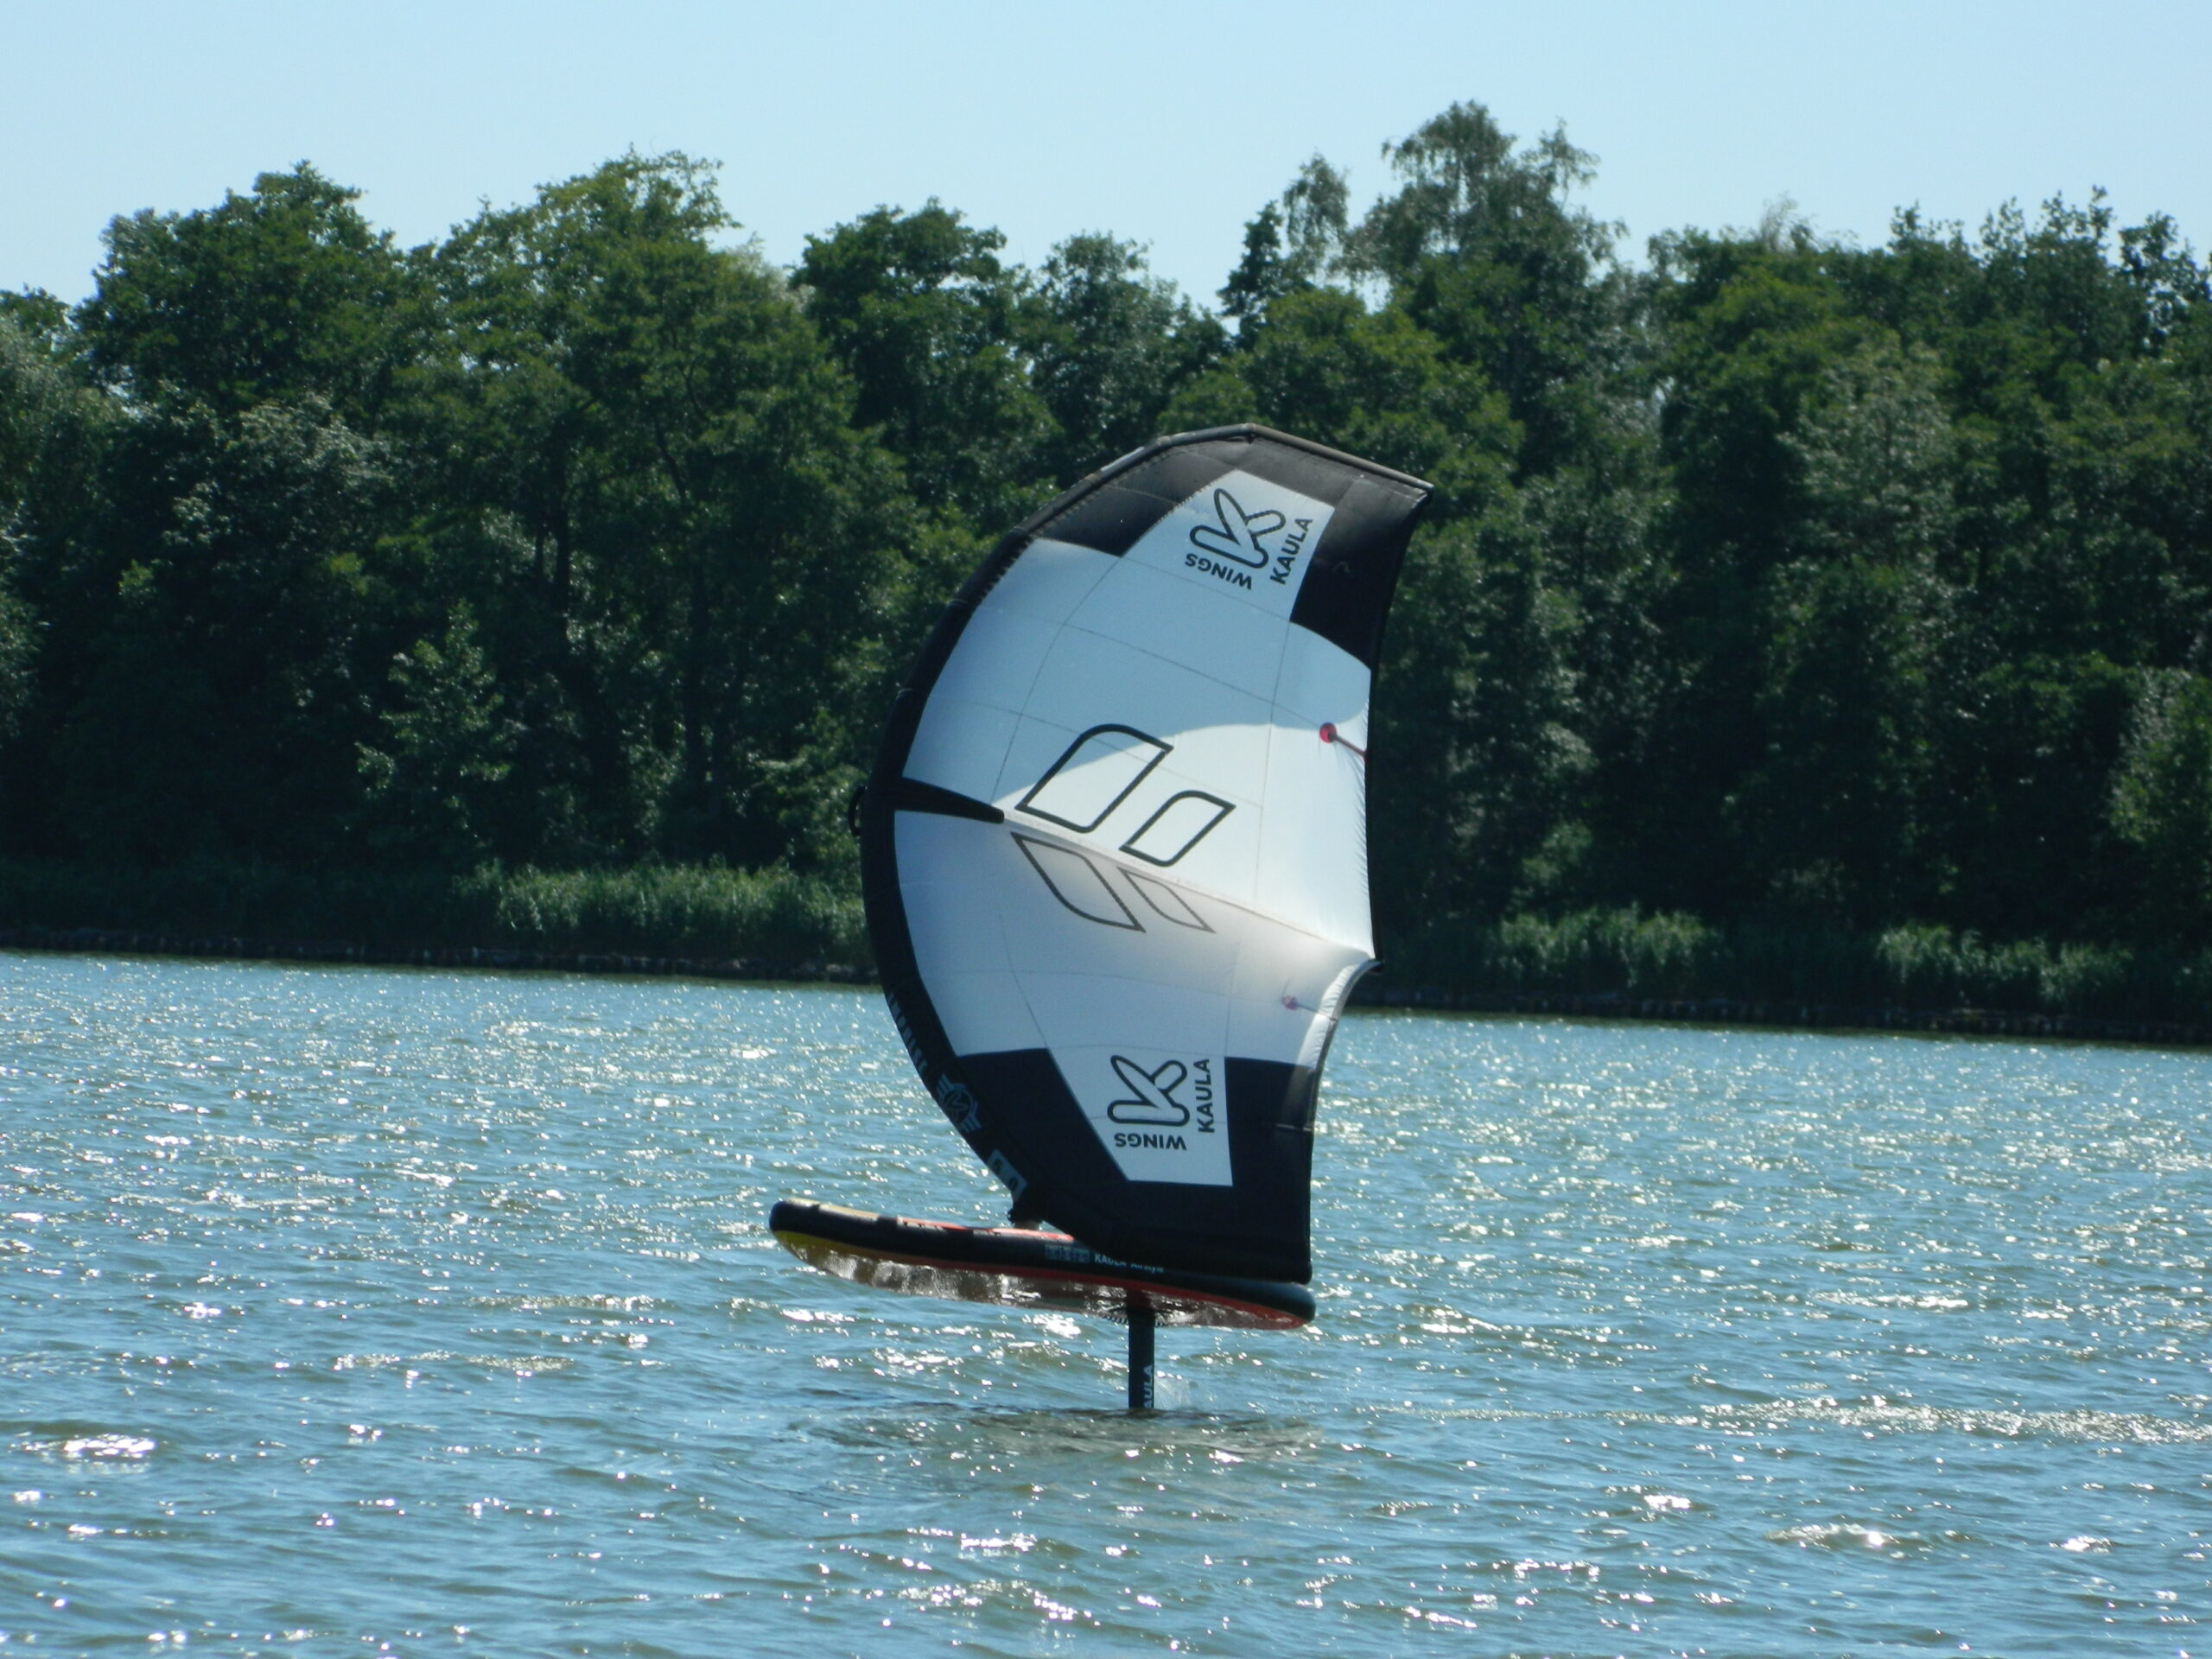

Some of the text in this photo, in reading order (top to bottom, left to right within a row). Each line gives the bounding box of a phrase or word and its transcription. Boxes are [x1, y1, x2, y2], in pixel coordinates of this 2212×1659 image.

[1185, 553, 1252, 590] WINGS
[1269, 518, 1313, 585] KAULA
[1193, 1058, 1215, 1133] KAULA
[1114, 1133, 1186, 1150] WINGS
[1144, 1365, 1153, 1408] AULA
